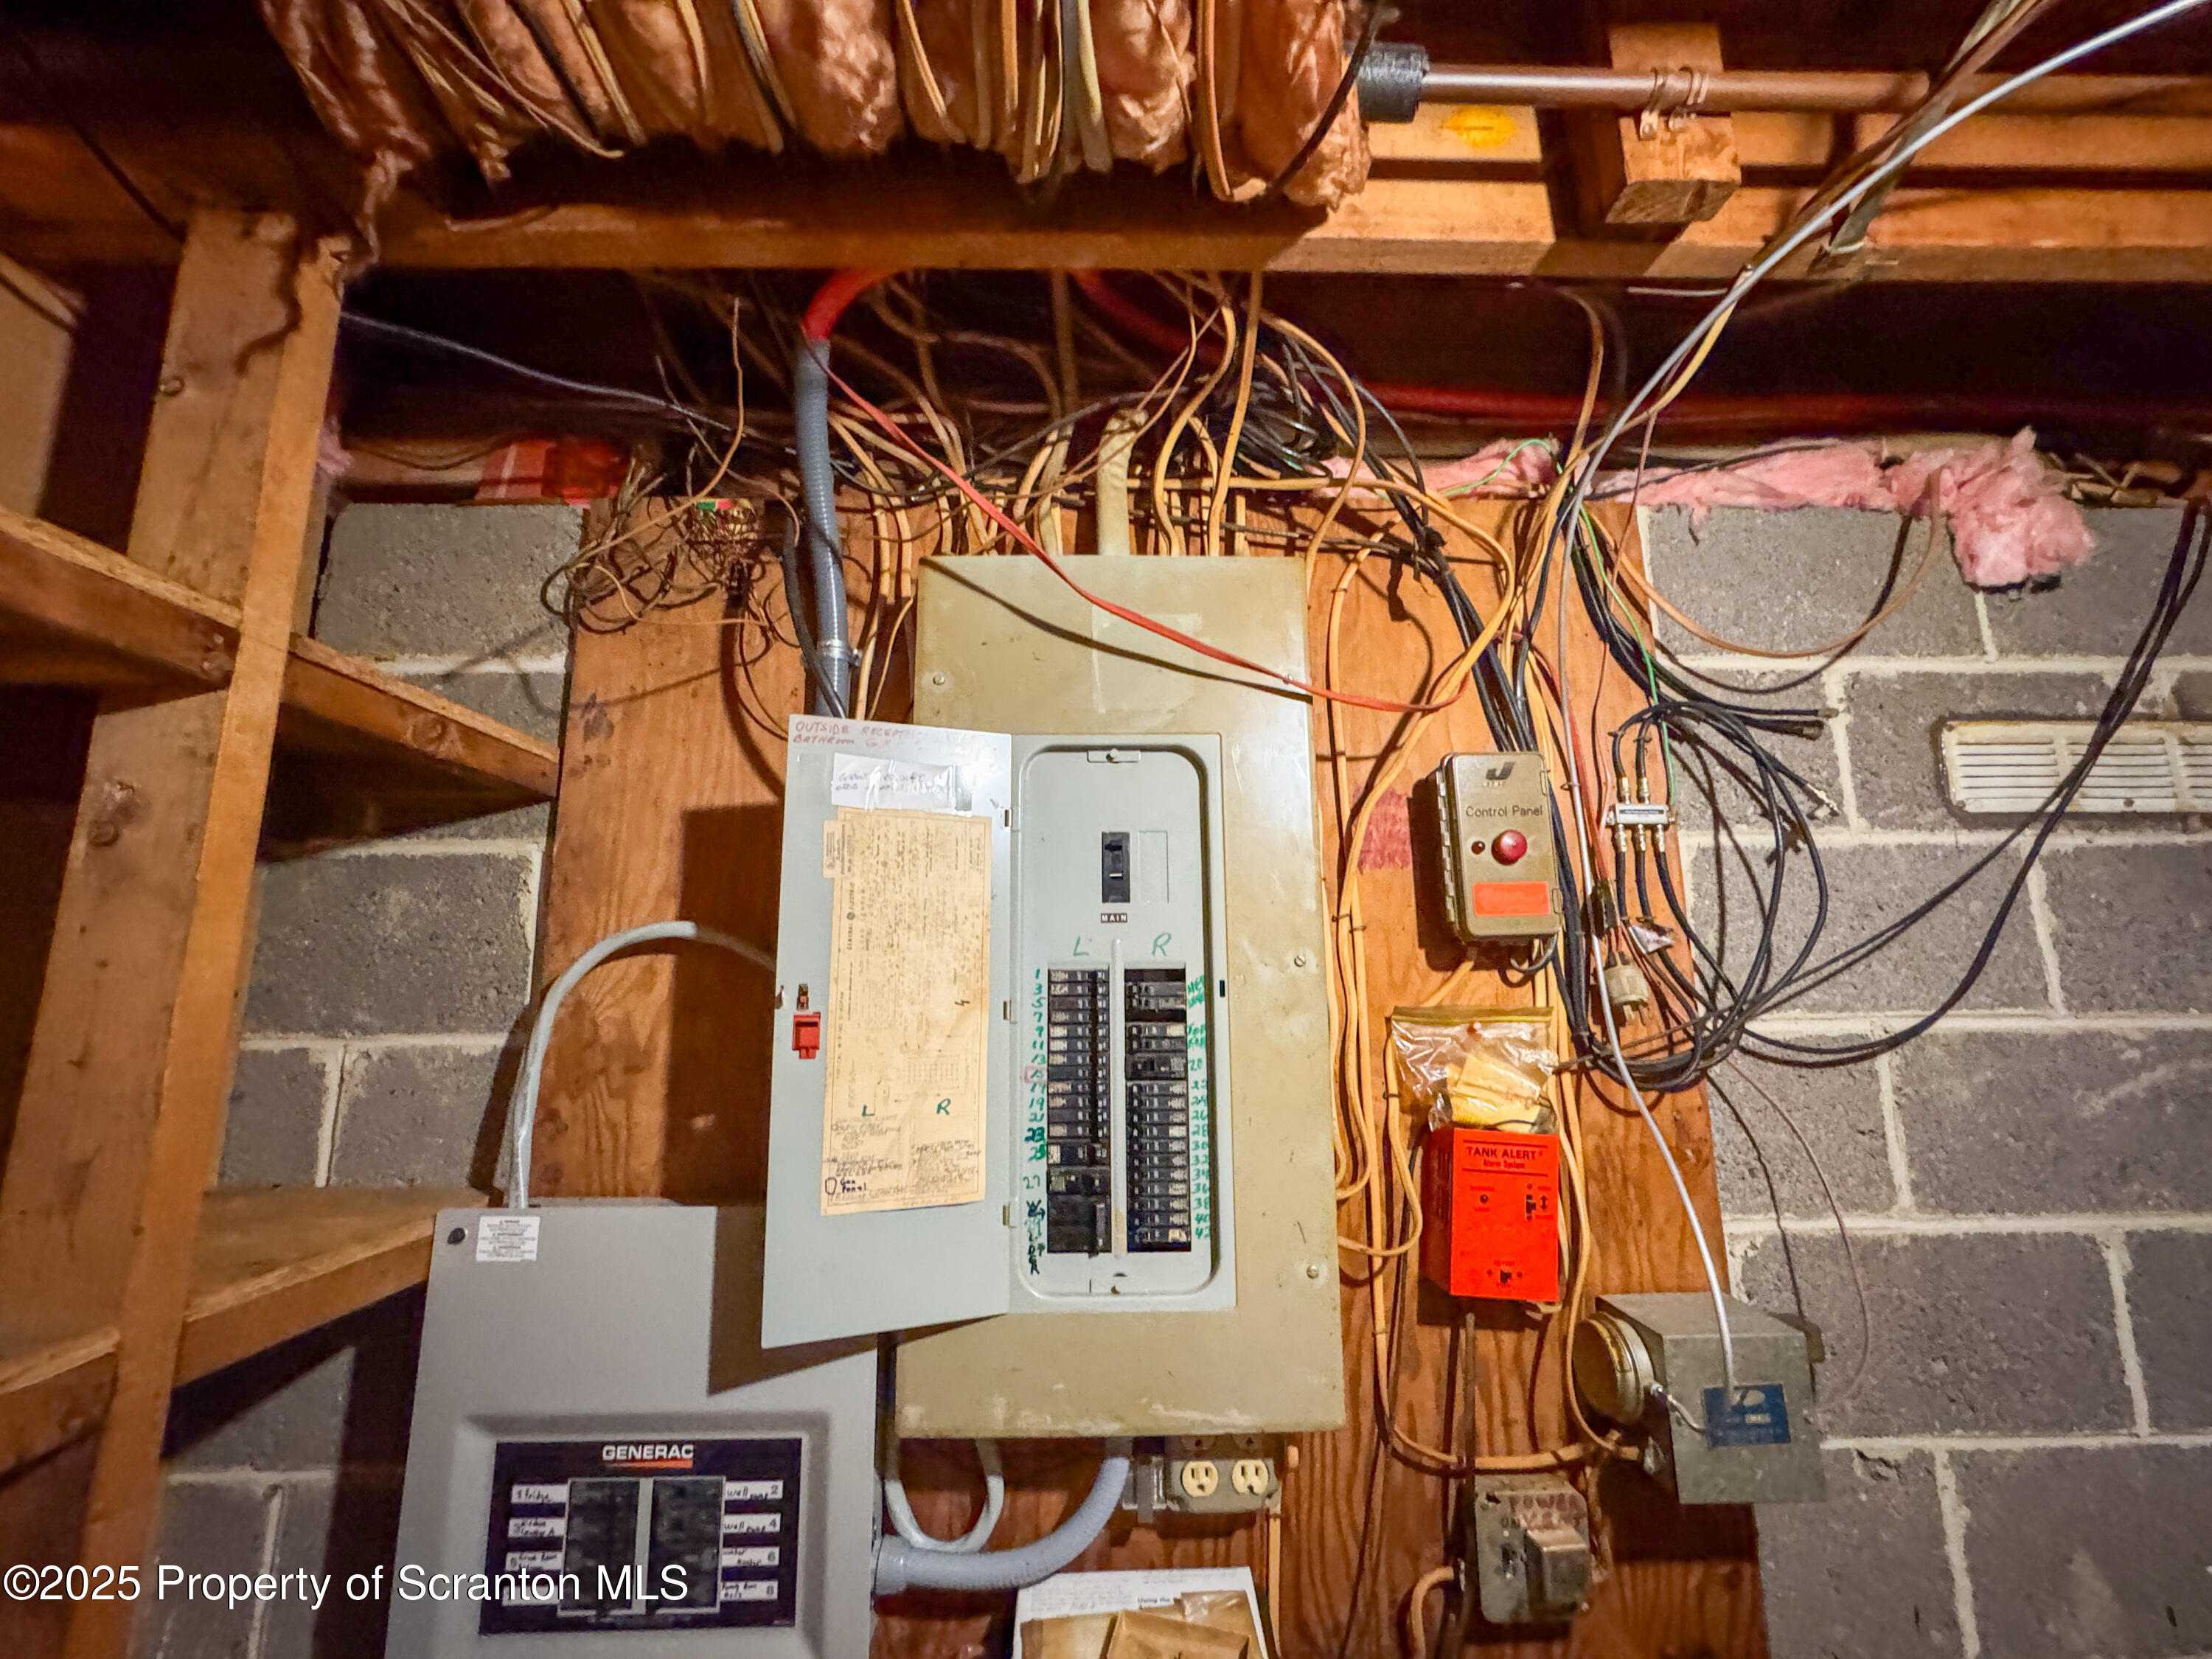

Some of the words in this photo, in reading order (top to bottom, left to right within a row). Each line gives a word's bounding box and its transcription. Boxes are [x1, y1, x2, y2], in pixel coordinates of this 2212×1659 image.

[796, 721, 849, 734] OUTSIDE
[1466, 805, 1507, 818] Control
[1512, 804, 1543, 816] Panel
[1101, 914, 1127, 922] MAIN
[1073, 936, 1090, 956] L
[1152, 932, 1172, 957] R
[1035, 968, 1040, 979] 1
[1034, 983, 1043, 995] 3
[1032, 996, 1046, 1009] 5
[1033, 1011, 1043, 1023] 7
[1036, 1026, 1044, 1037] 9
[1032, 1040, 1044, 1050] 11
[1032, 1054, 1046, 1065] 13
[936, 1098, 951, 1115] R
[1029, 1096, 1044, 1111] 19
[861, 1105, 875, 1117] L
[1467, 1146, 1498, 1158] TANK
[1502, 1149, 1537, 1161] ALERT
[1192, 1154, 1208, 1166] 32
[1192, 1168, 1208, 1180] 34
[1023, 1175, 1040, 1189] 27
[1192, 1183, 1208, 1194] 36
[1192, 1197, 1209, 1209] 38
[602, 1444, 694, 1461] GENERAC
[771, 1485, 778, 1495] 2
[769, 1518, 777, 1528] 4
